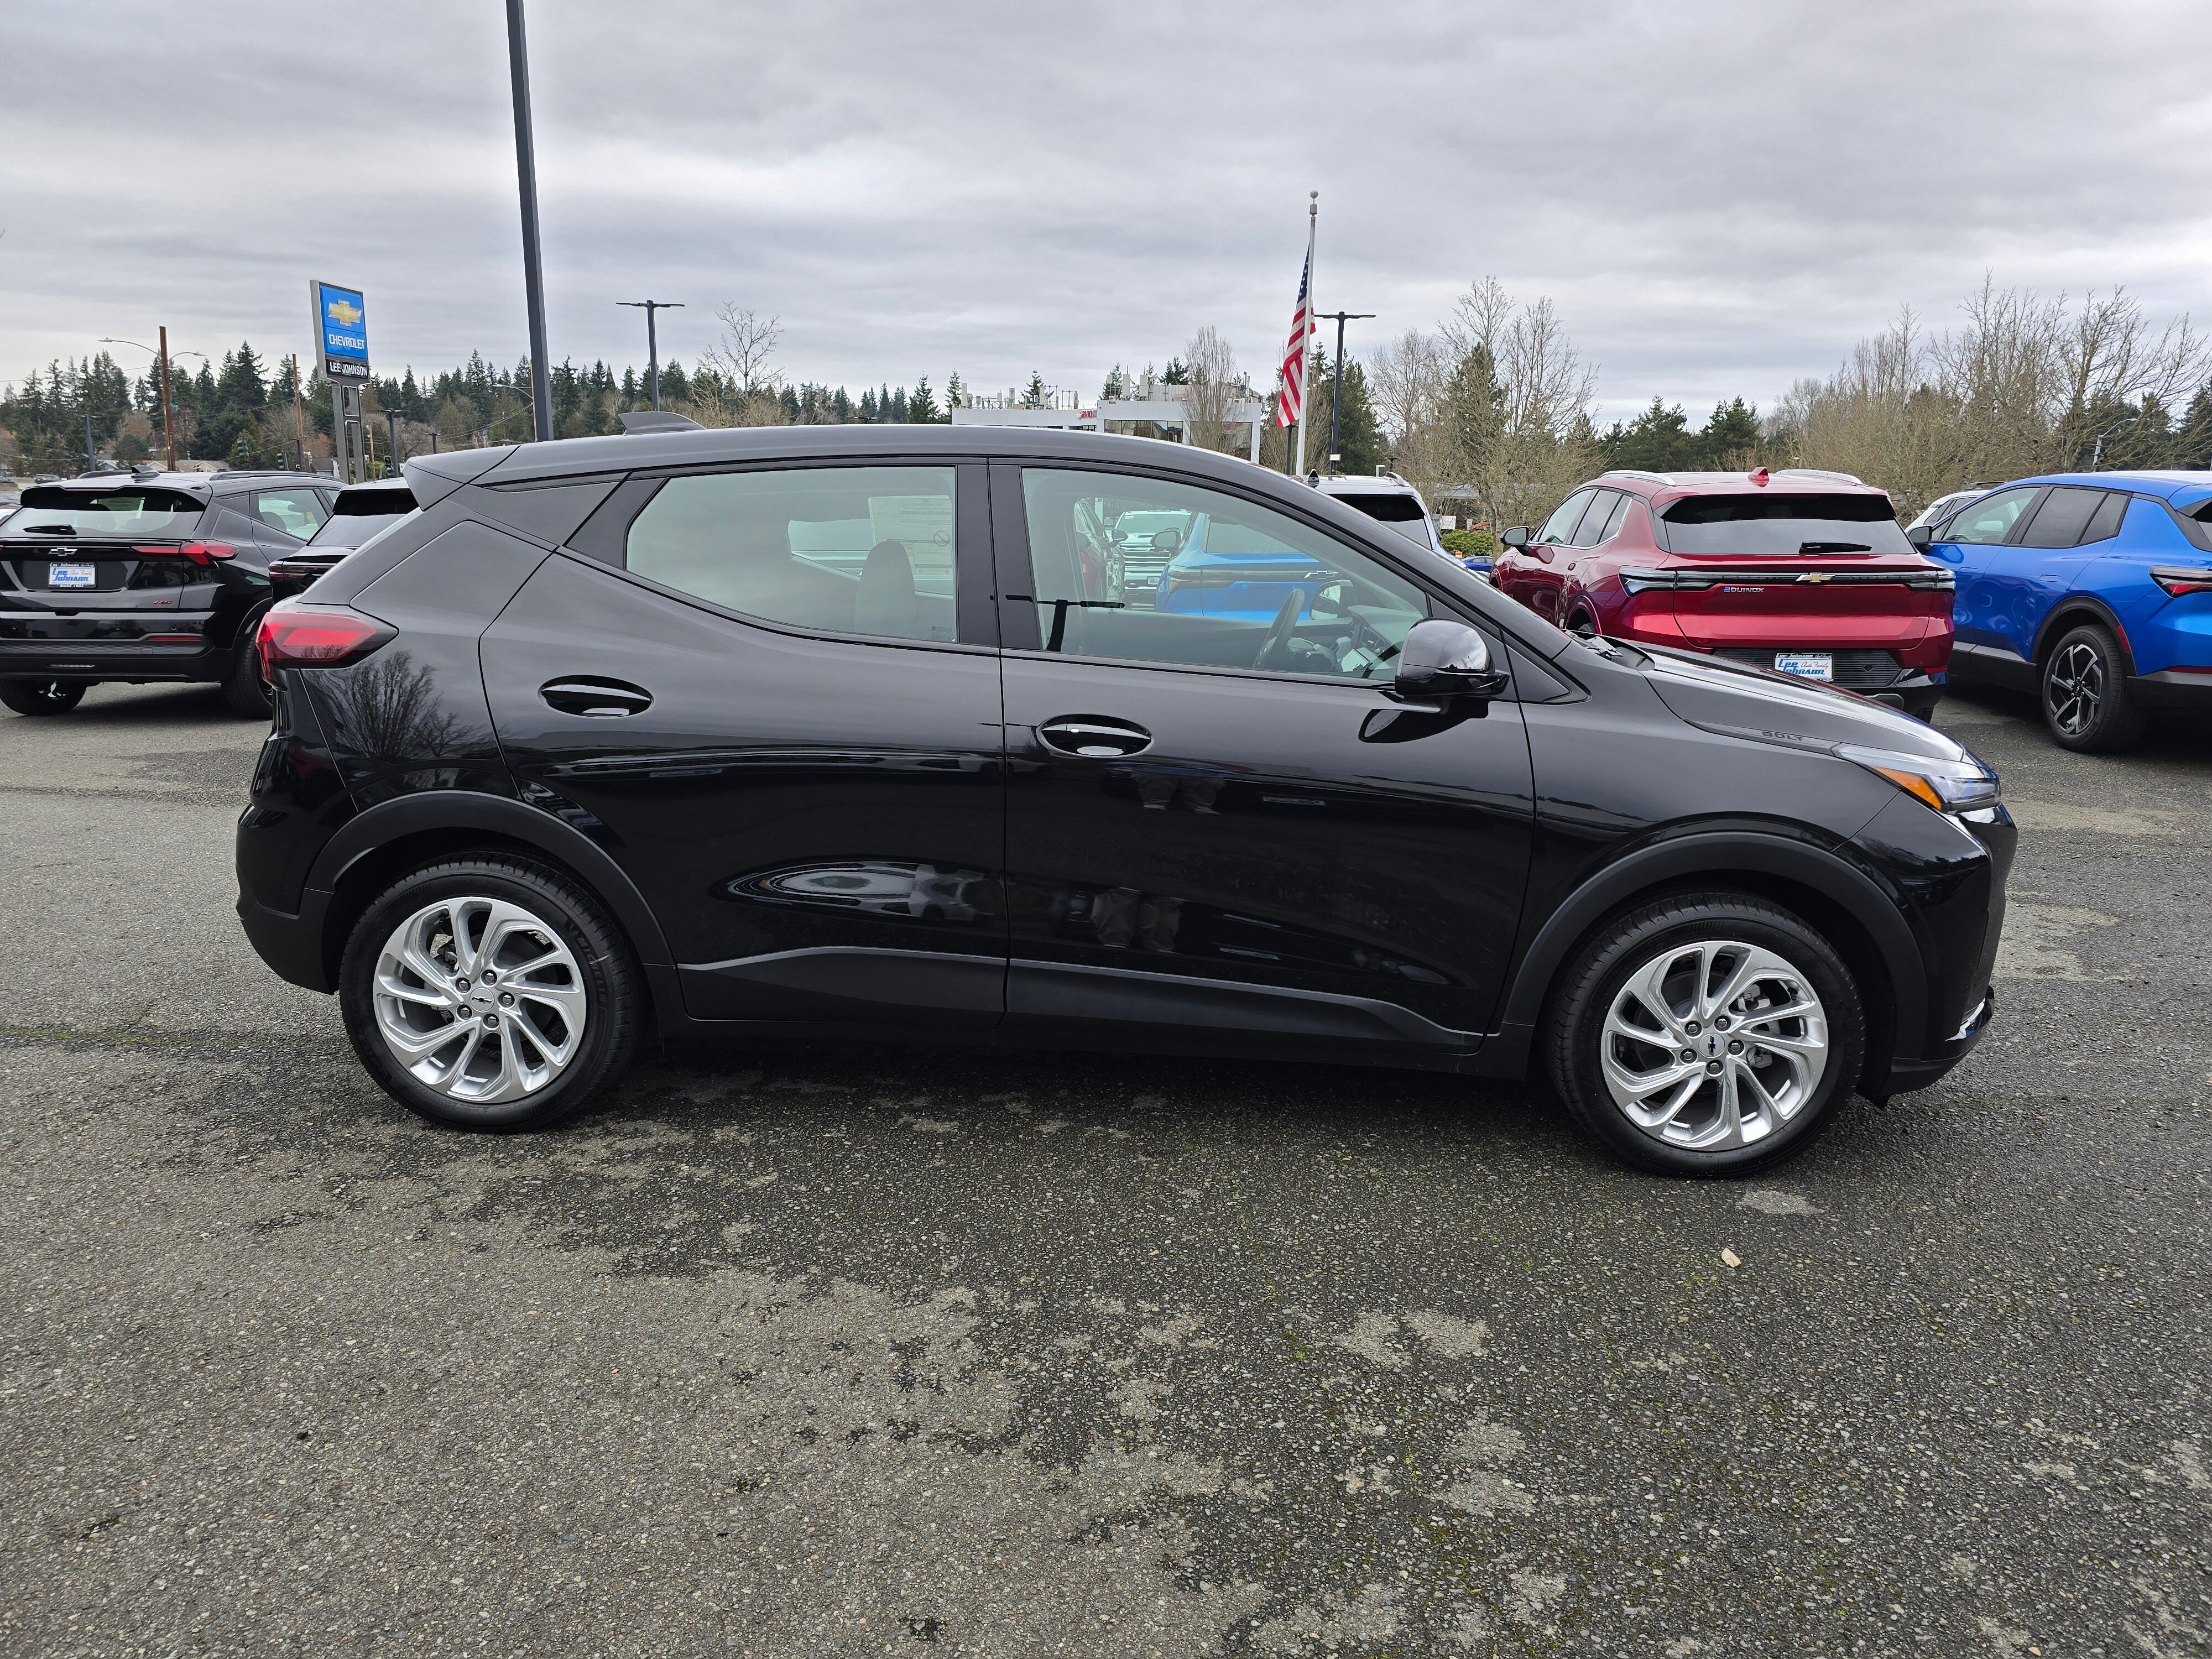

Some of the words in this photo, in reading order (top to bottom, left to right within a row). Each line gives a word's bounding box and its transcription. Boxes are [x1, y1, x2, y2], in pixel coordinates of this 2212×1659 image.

[328, 333, 365, 350] CHEVROLET
[330, 362, 341, 373] LEE
[342, 364, 368, 377] JOHNSON
[1778, 659, 1799, 667] Lee
[1761, 731, 1804, 742] BOLT
[576, 937, 607, 1003] MICHELIN
